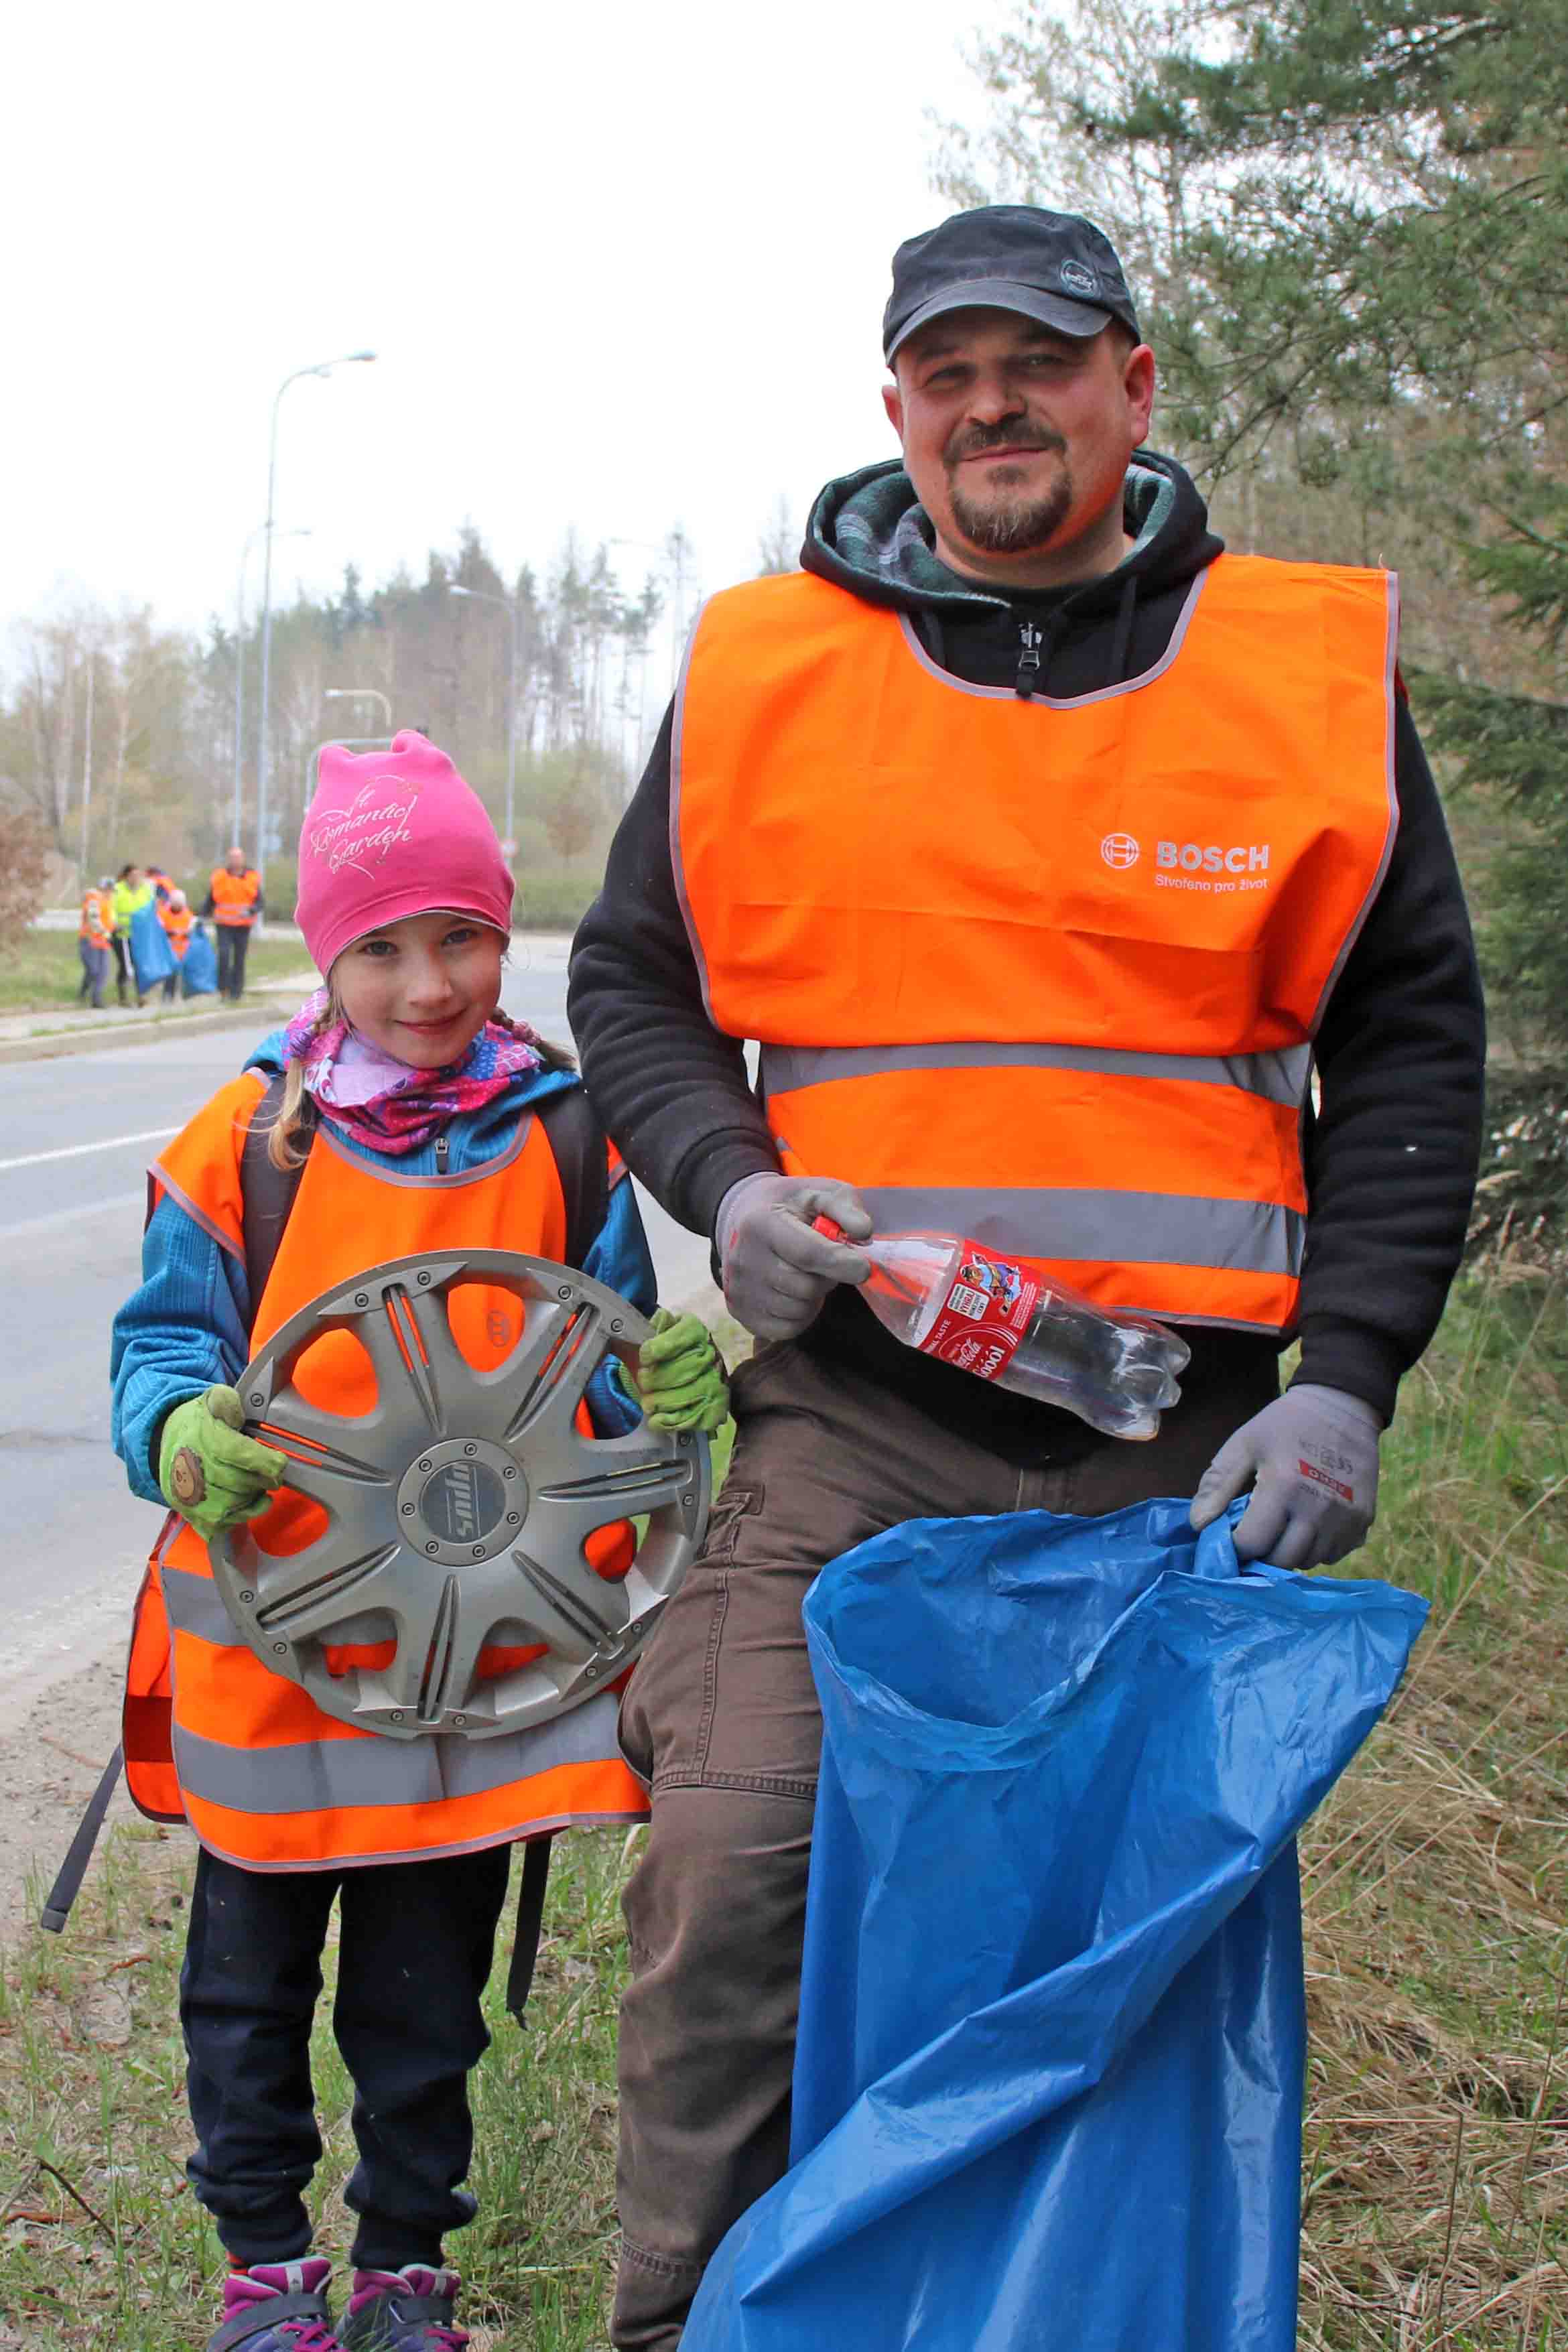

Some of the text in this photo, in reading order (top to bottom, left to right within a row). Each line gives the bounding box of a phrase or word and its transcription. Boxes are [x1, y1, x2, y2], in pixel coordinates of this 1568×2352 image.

[329, 825, 413, 874] Garden
[1157, 840, 1270, 873] BOSCH
[1214, 881, 1236, 893] pro
